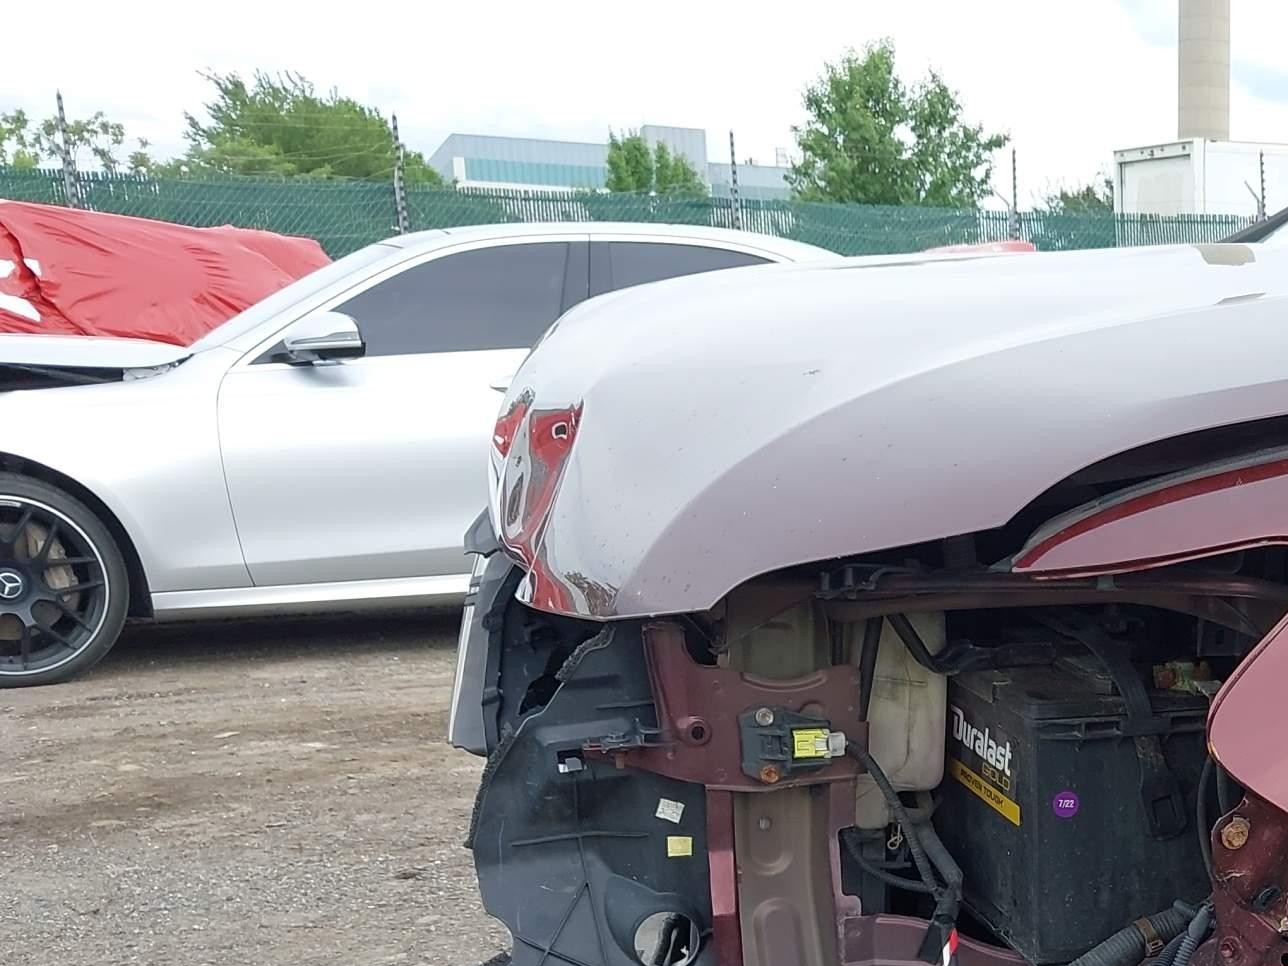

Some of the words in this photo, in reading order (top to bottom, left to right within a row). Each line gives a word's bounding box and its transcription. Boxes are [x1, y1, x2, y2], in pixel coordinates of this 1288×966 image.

[951, 704, 1012, 777] Duralast
[960, 768, 983, 794] PROVEN
[983, 784, 1005, 808] TOUGH
[982, 763, 1011, 791] GOLD
[1058, 799, 1075, 808] 7/22
